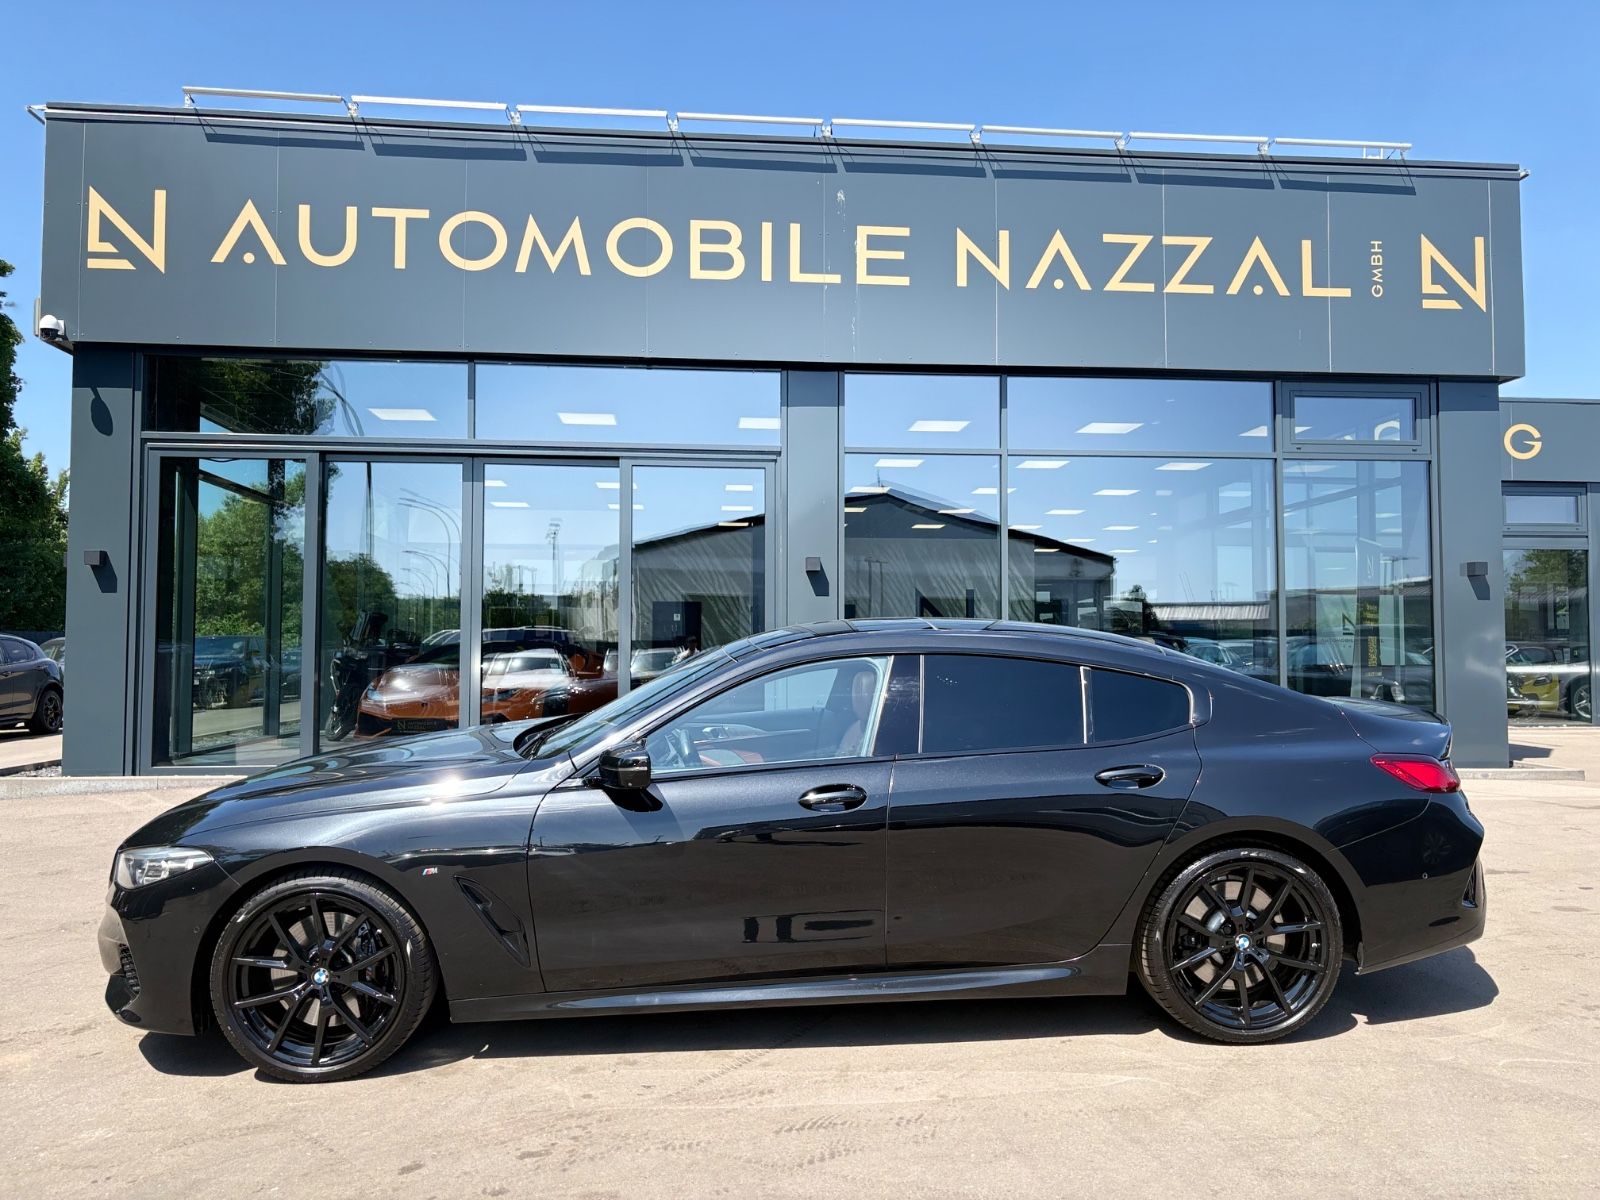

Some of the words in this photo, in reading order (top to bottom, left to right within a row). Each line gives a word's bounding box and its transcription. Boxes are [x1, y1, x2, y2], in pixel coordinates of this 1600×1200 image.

[210, 198, 911, 287] AUTOMOBILE
[955, 228, 1352, 298] NAZZAL
[1370, 240, 1384, 298] GMBH
[1503, 423, 1543, 461] G
